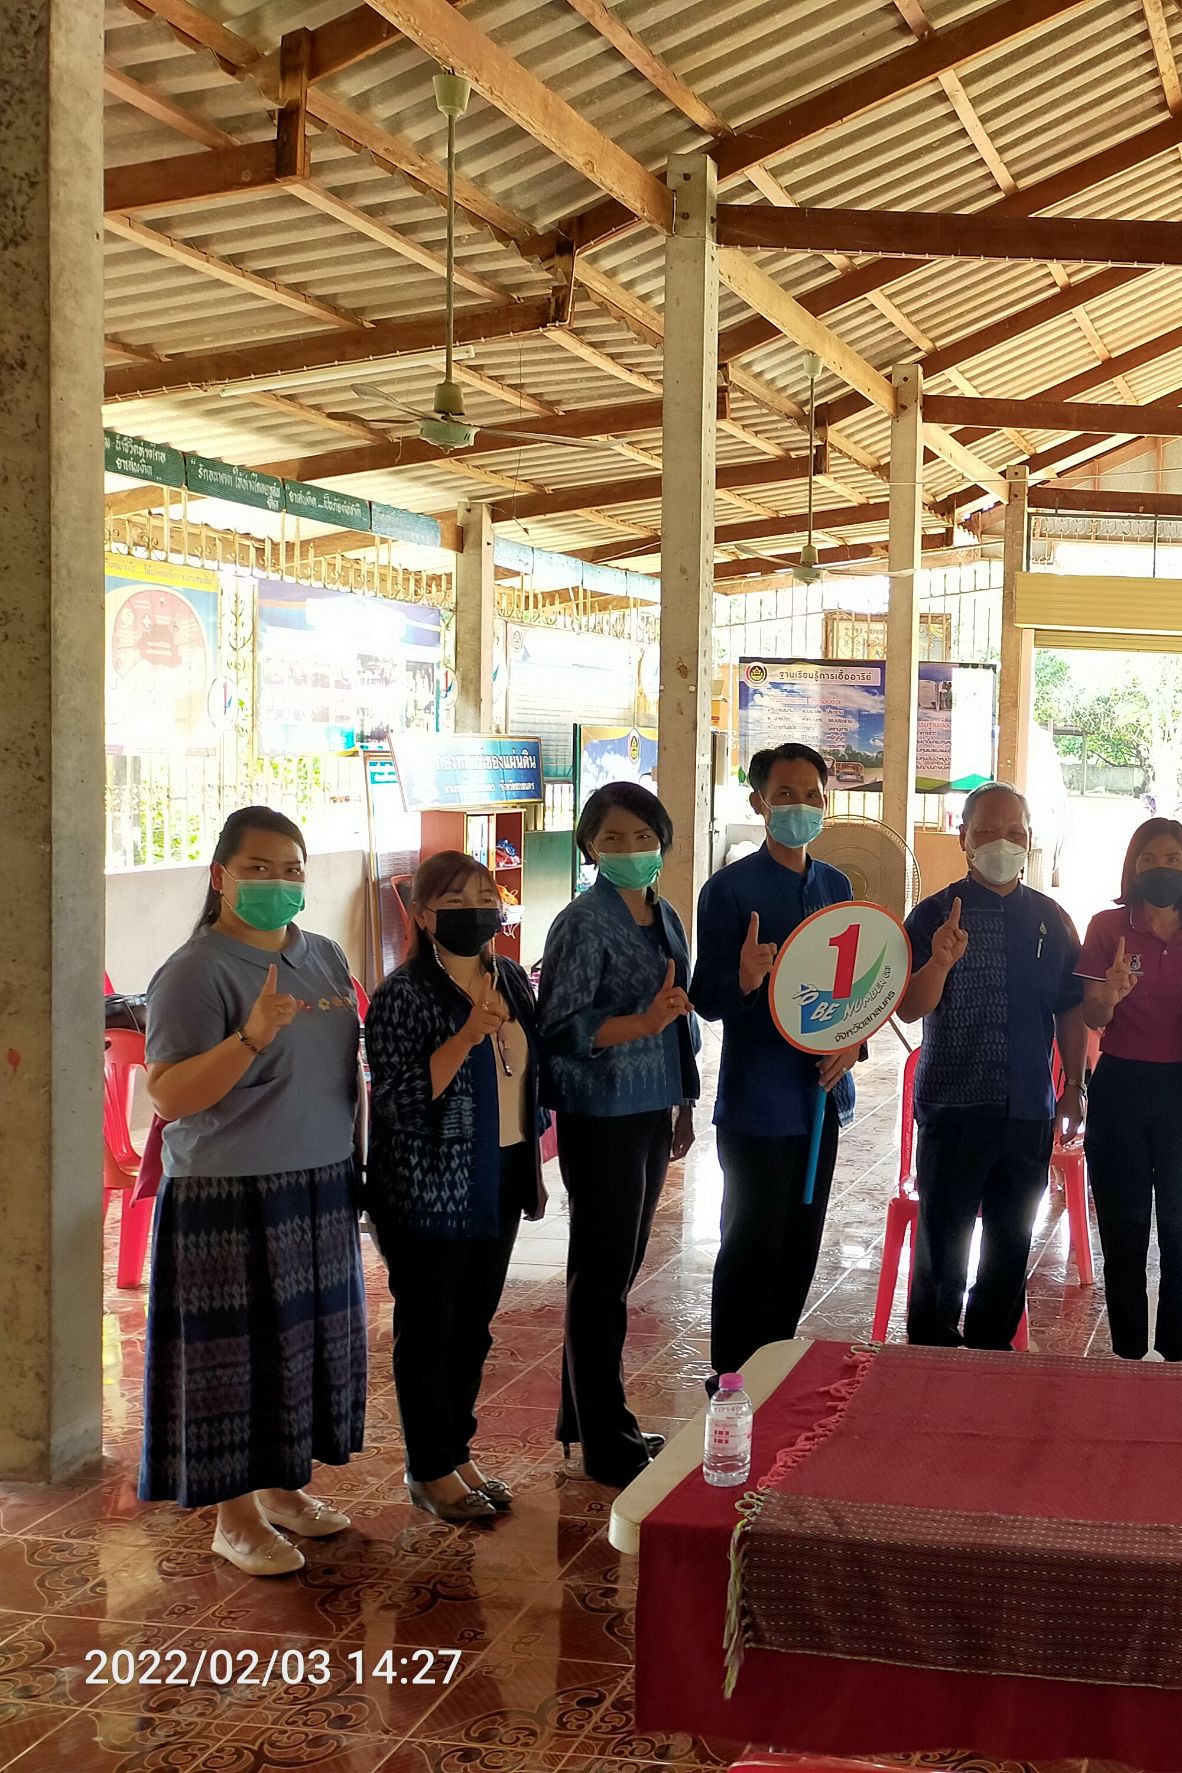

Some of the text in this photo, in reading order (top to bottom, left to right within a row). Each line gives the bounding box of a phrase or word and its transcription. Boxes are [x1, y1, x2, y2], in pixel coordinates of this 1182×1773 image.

[828, 923, 861, 1000] 1
[810, 1001, 841, 1023] BE
[842, 978, 887, 1022] NUMBER
[833, 990, 896, 1043] จังหวัดสกลนคร
